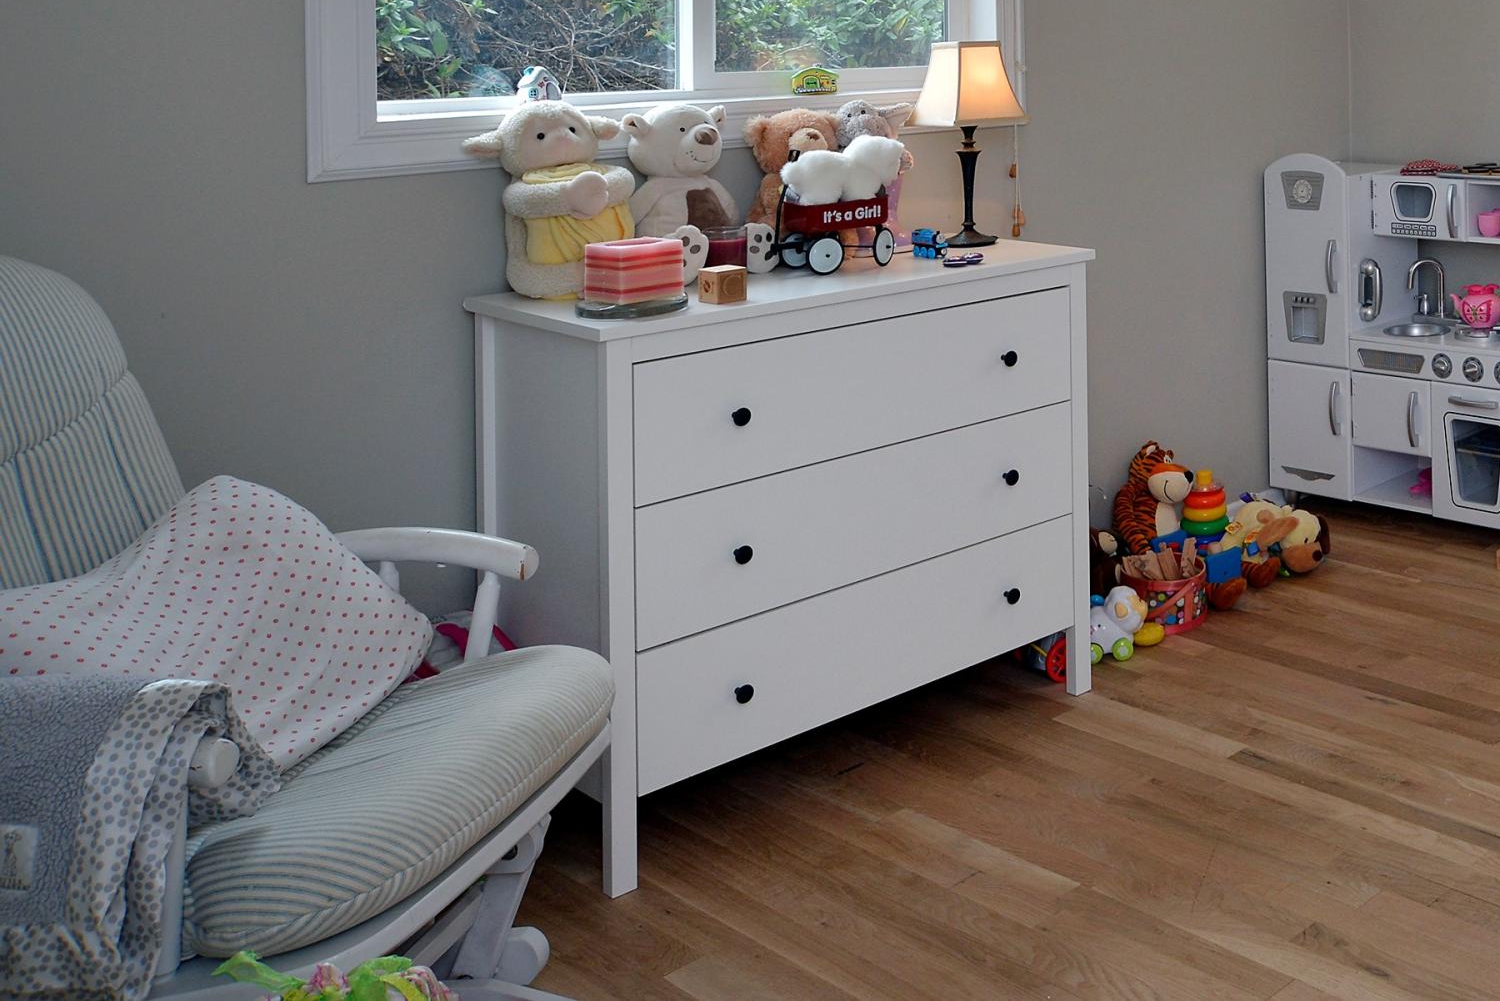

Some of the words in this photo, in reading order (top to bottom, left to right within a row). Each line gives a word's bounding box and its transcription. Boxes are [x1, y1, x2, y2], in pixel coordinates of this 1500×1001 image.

[823, 210, 842, 224] It's
[844, 210, 853, 221] a
[854, 204, 881, 220] Girl!
